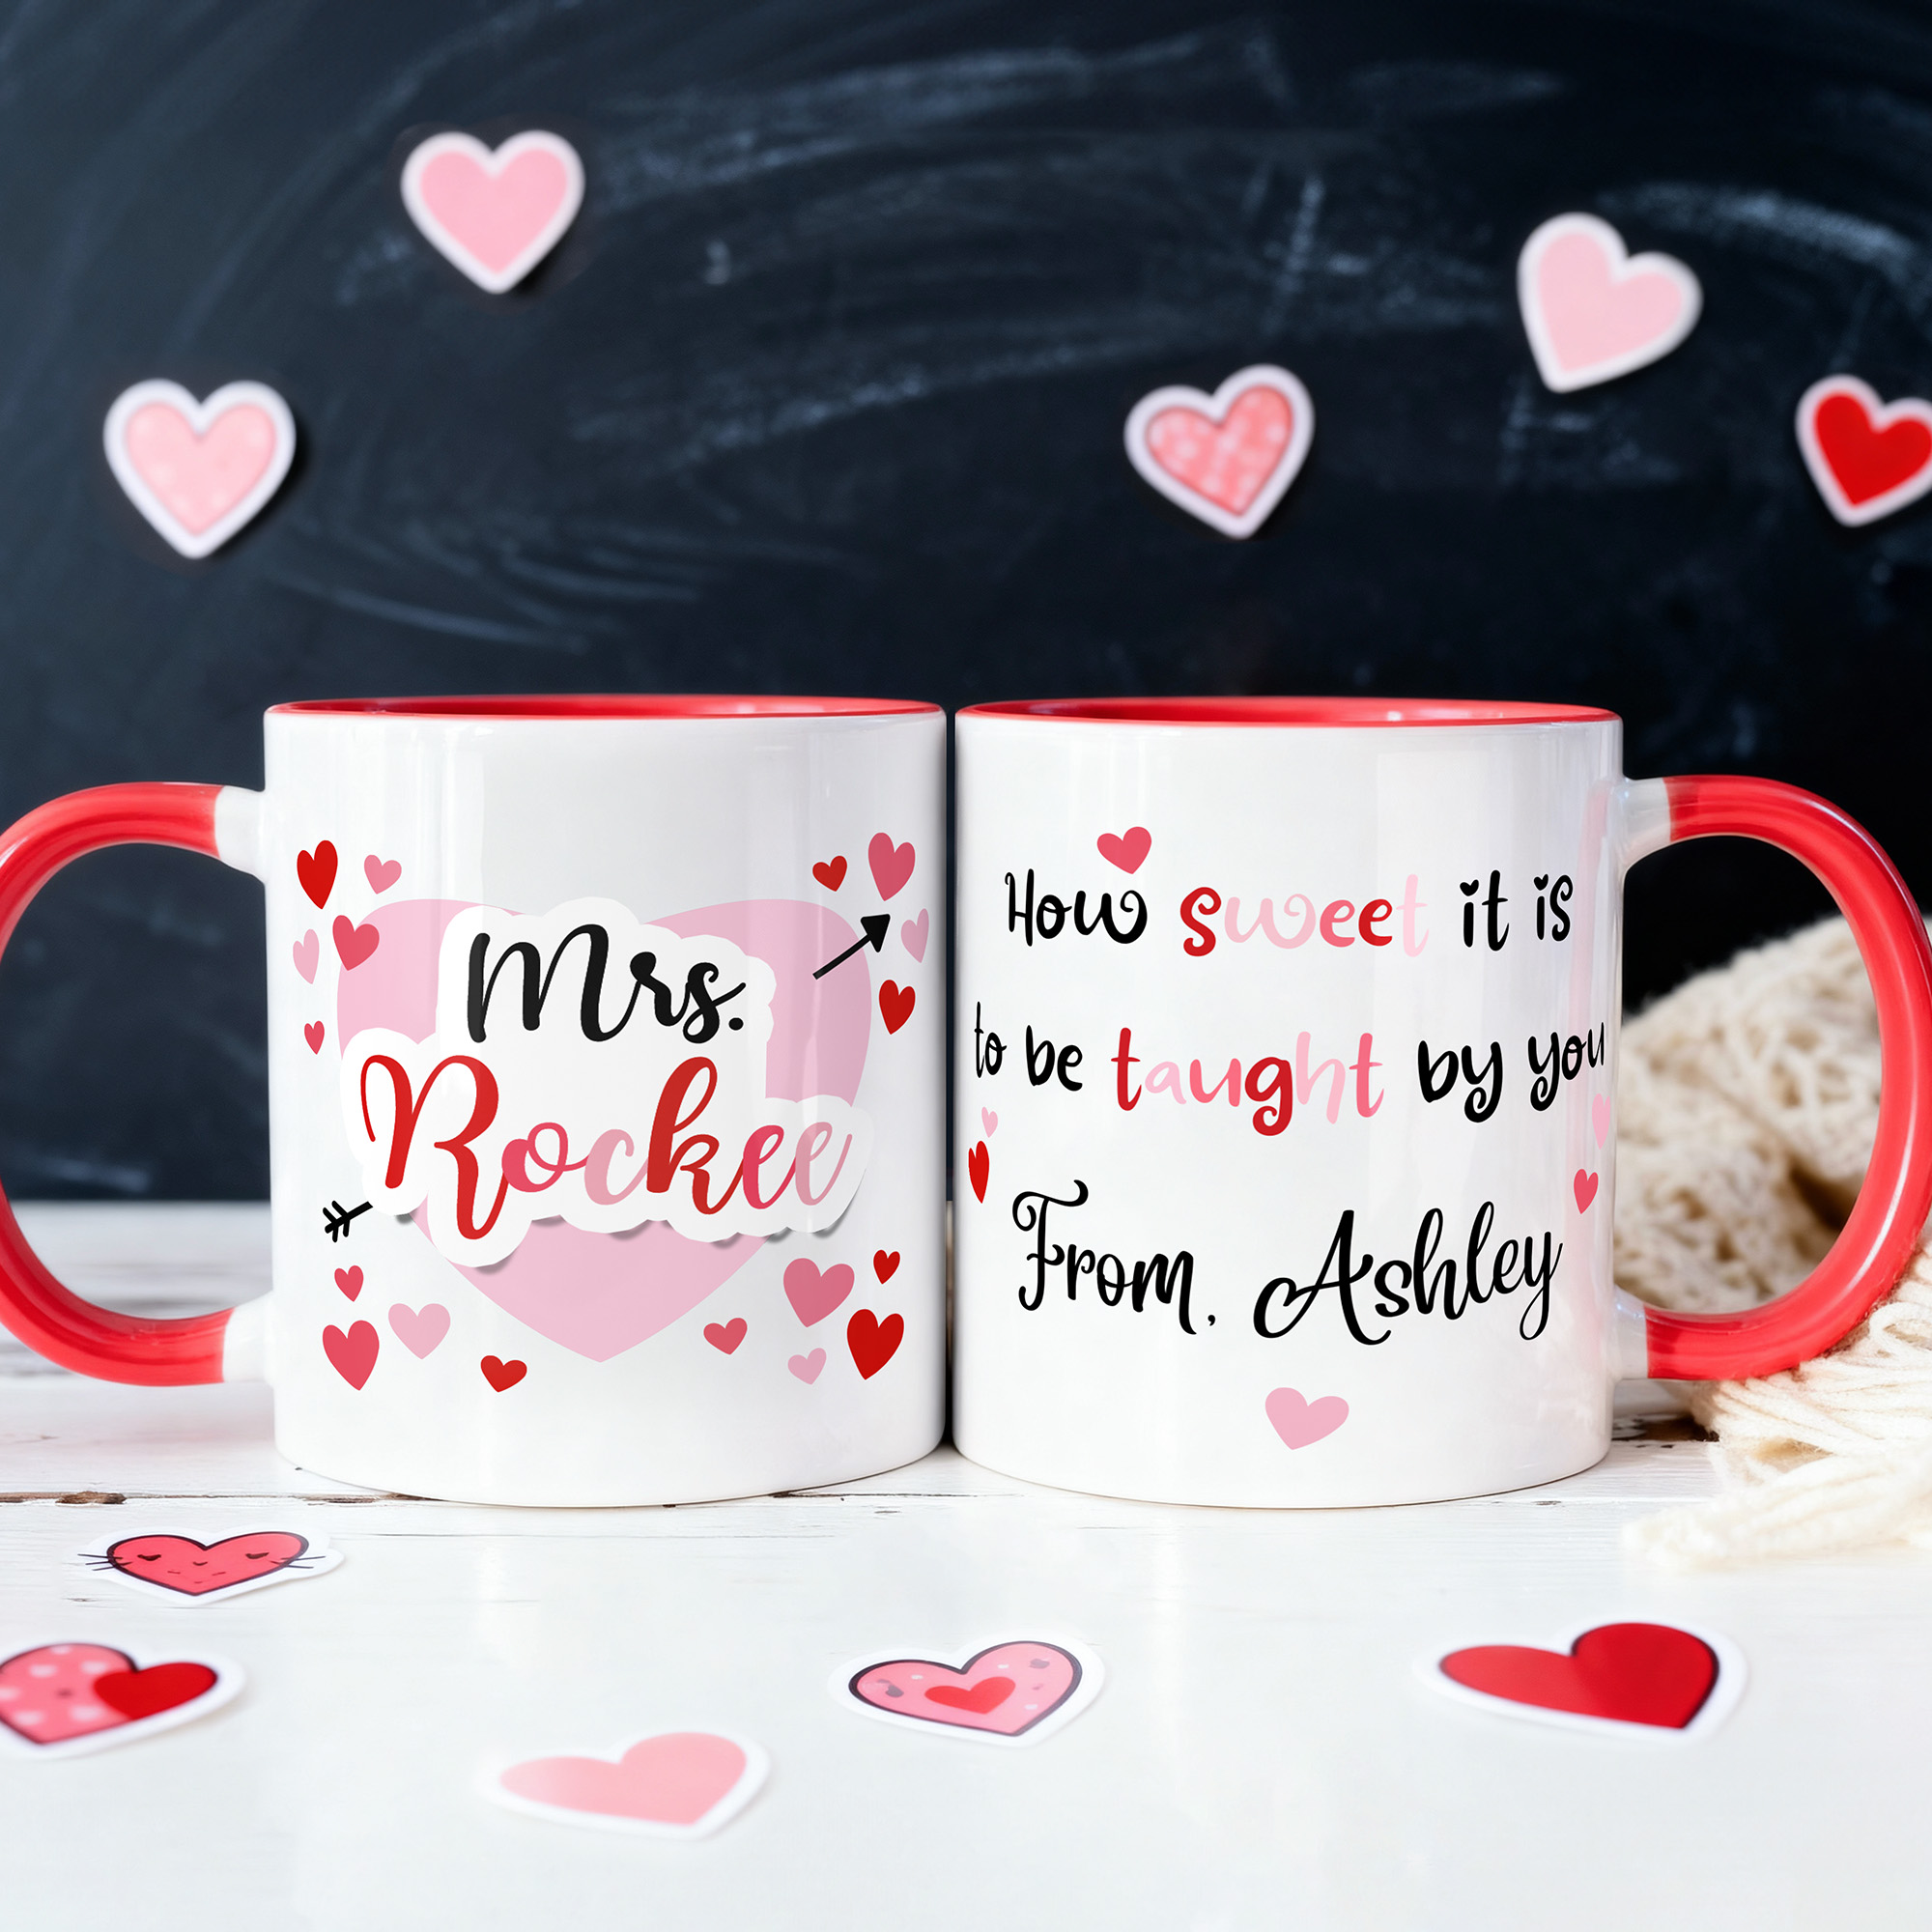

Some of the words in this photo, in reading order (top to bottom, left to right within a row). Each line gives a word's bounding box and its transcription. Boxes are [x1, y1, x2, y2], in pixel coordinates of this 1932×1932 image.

[1005, 868, 1148, 946] How
[1179, 874, 1429, 957] sweet
[1459, 869, 1510, 952] it
[1533, 874, 1574, 942] is
[467, 923, 746, 1044] Mrs.
[974, 1002, 1008, 1078] to
[1026, 1025, 1083, 1091] be
[1111, 1027, 1384, 1136] taught
[1418, 1039, 1503, 1122] by
[1527, 1022, 1605, 1112] you
[360, 1055, 853, 1240] Rockee
[1011, 1179, 1217, 1335] From,
[1253, 1201, 1564, 1346] Ashley
